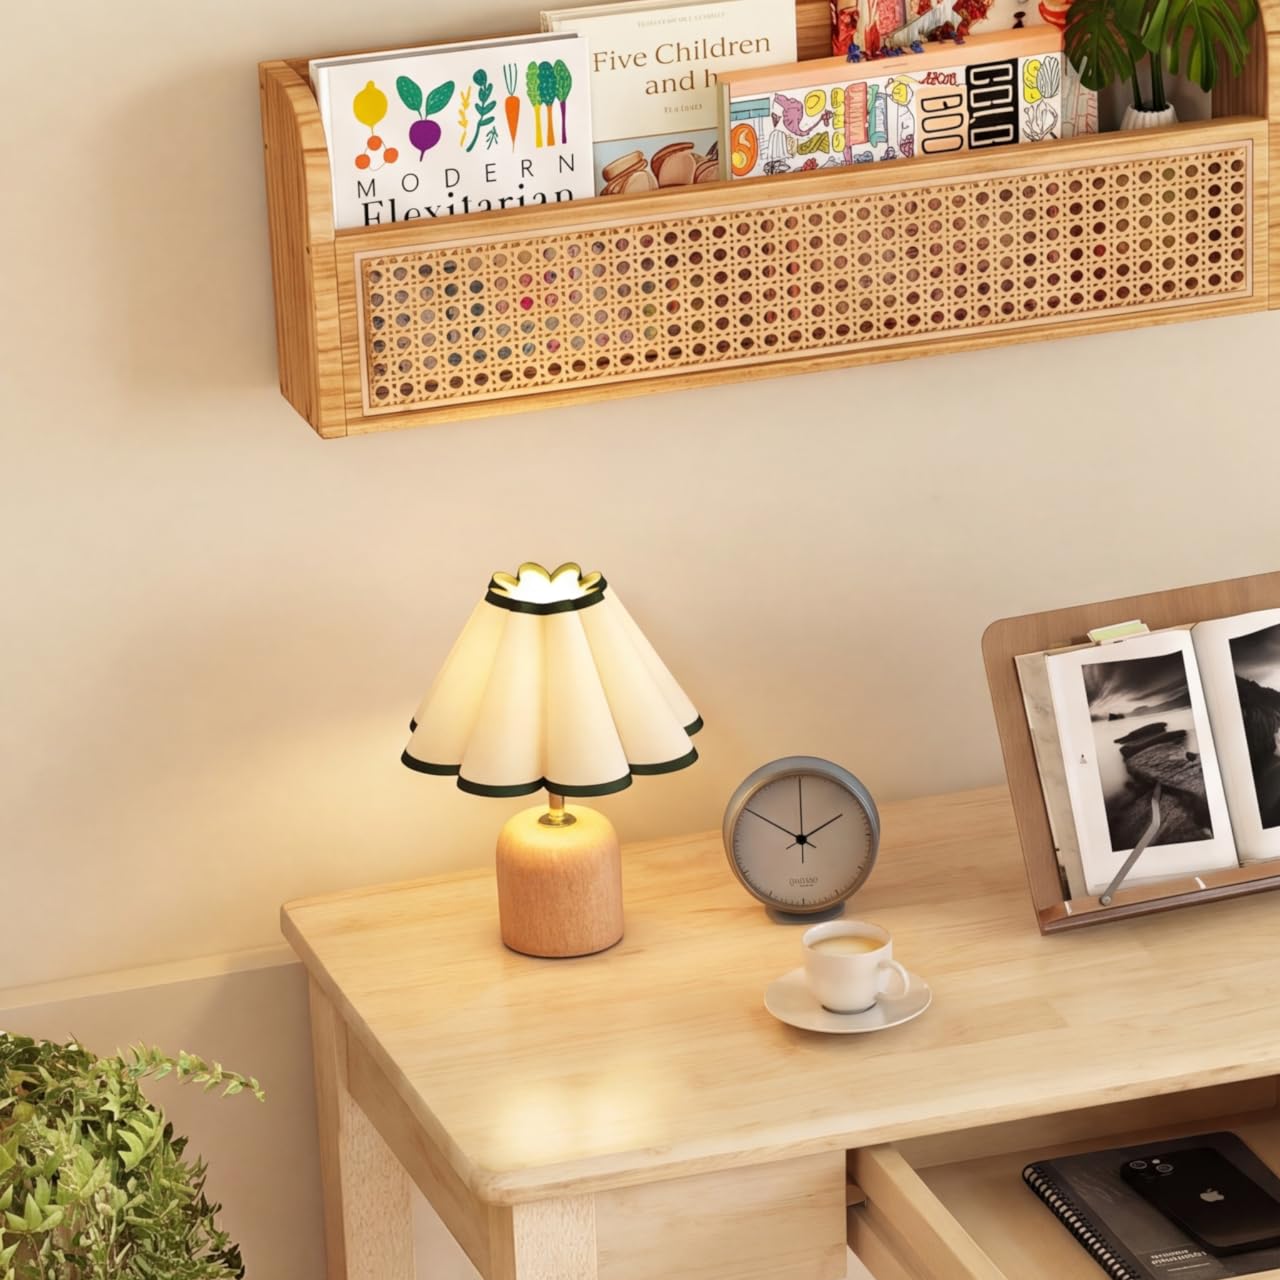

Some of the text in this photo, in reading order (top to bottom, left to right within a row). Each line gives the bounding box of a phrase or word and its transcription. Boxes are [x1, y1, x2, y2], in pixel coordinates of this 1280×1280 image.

[592, 36, 771, 73] Five Children
[644, 70, 696, 95] and
[356, 153, 575, 198] MODERN
